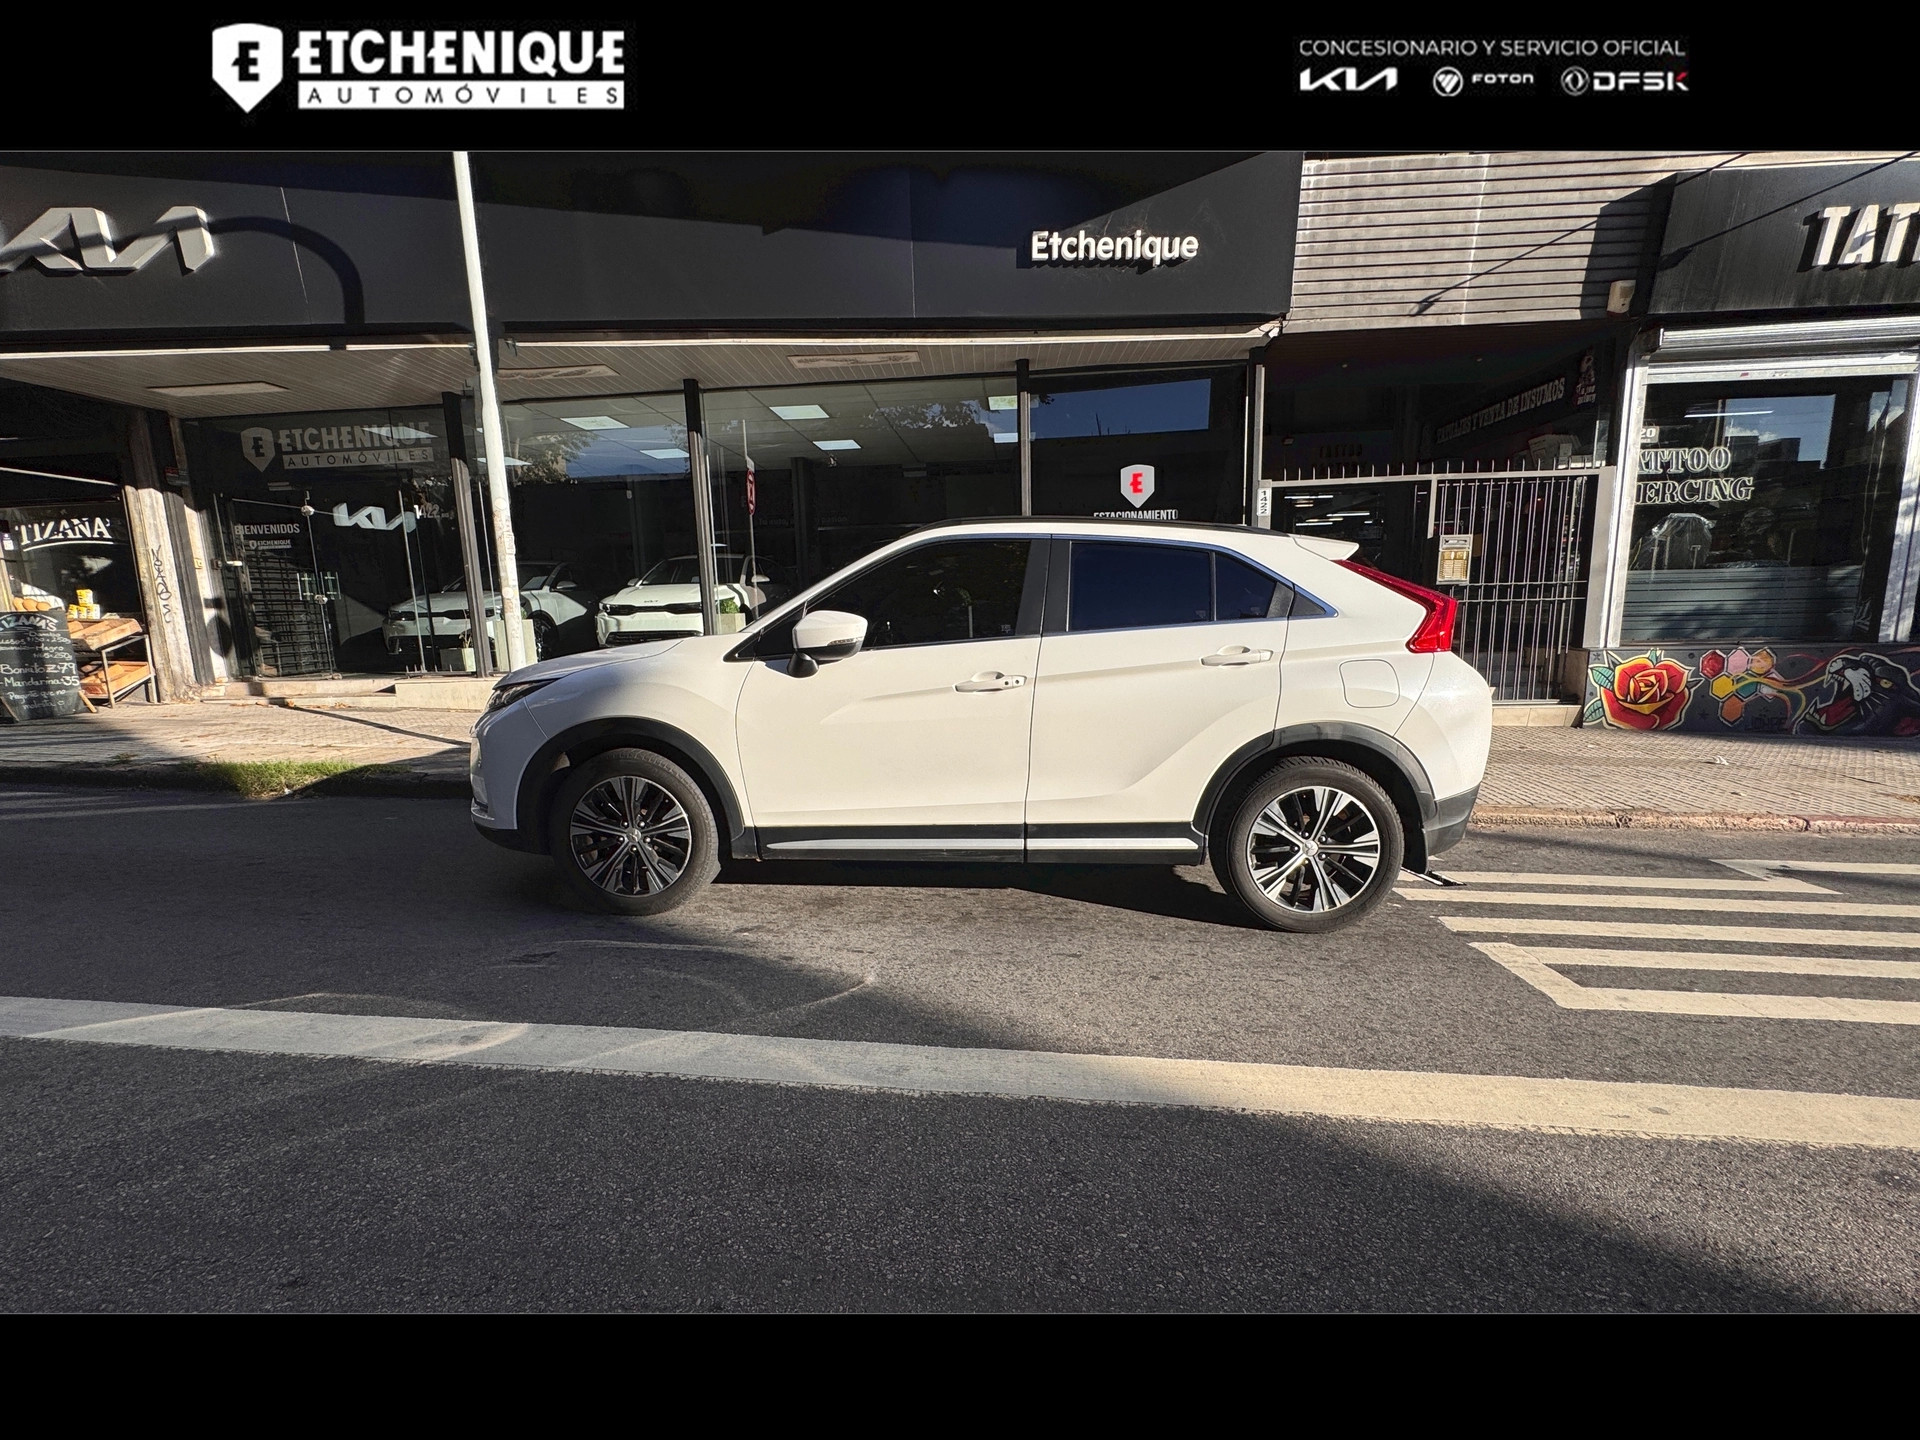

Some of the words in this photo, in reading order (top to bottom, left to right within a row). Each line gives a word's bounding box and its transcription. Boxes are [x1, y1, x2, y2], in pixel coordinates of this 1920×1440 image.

[1031, 229, 1199, 266] Etchenique
[1812, 203, 1920, 267] TAT
[1519, 376, 1566, 412] INSUMOS
[278, 421, 433, 452] ETCHENIQUE
[287, 450, 429, 467] AUTOMÓVILES
[1637, 446, 1732, 475] ATTOO
[1635, 476, 1755, 505] IERCING
[234, 523, 301, 535] BIENVENIDOS
[0, 615, 58, 632] IZANA'S
